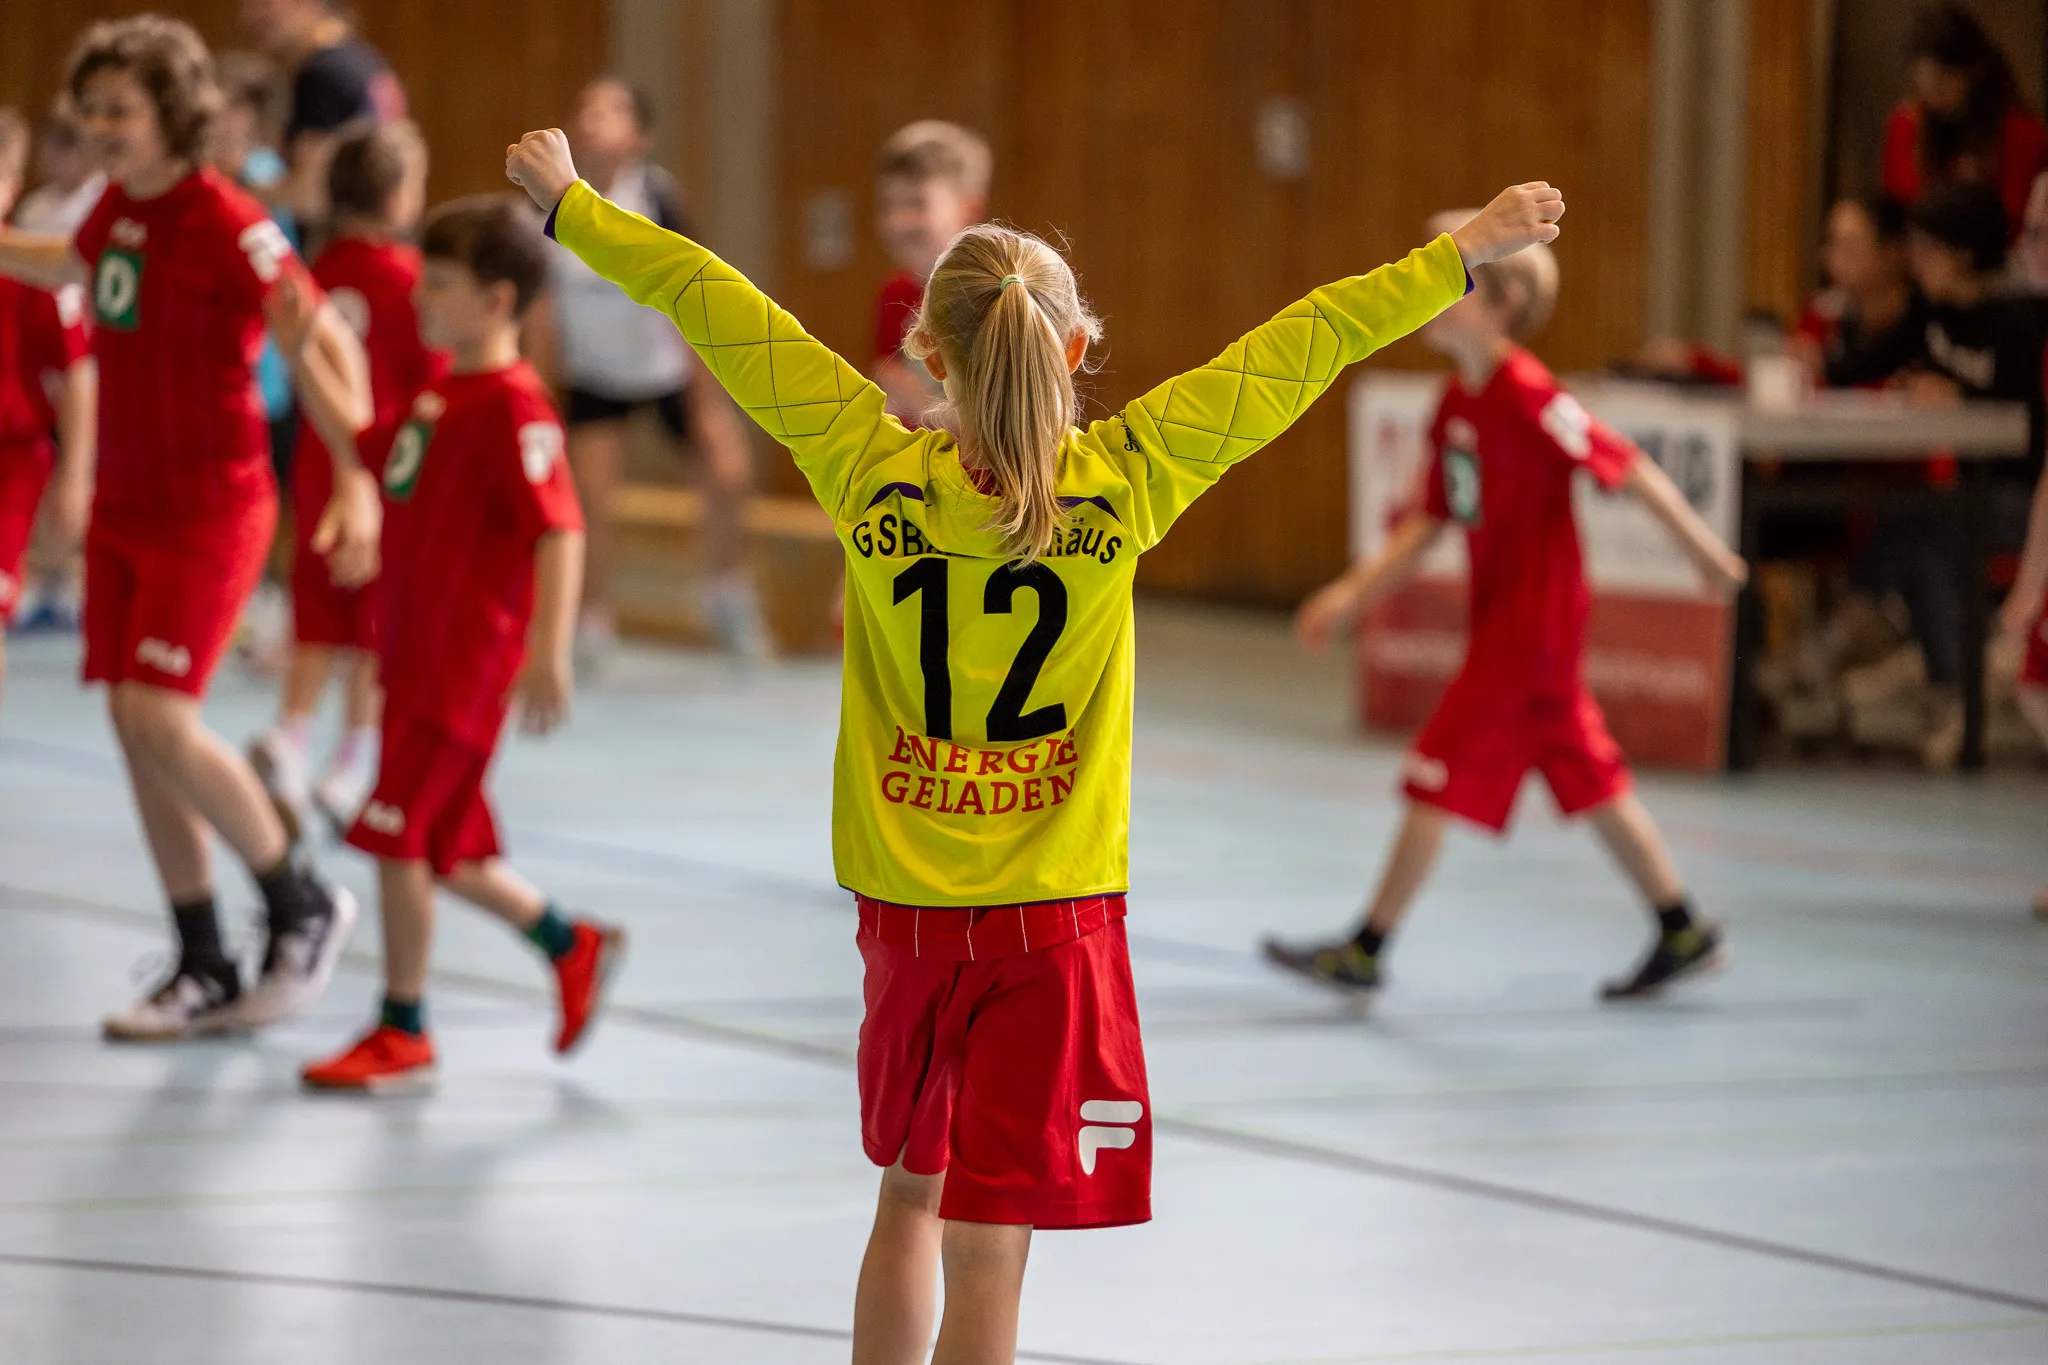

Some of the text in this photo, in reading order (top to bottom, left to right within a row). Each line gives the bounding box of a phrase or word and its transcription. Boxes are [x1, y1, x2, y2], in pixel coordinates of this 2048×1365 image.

[892, 556, 1069, 743] 12
[888, 725, 1079, 776] ENERGIE
[881, 767, 1078, 816] GELADEN
